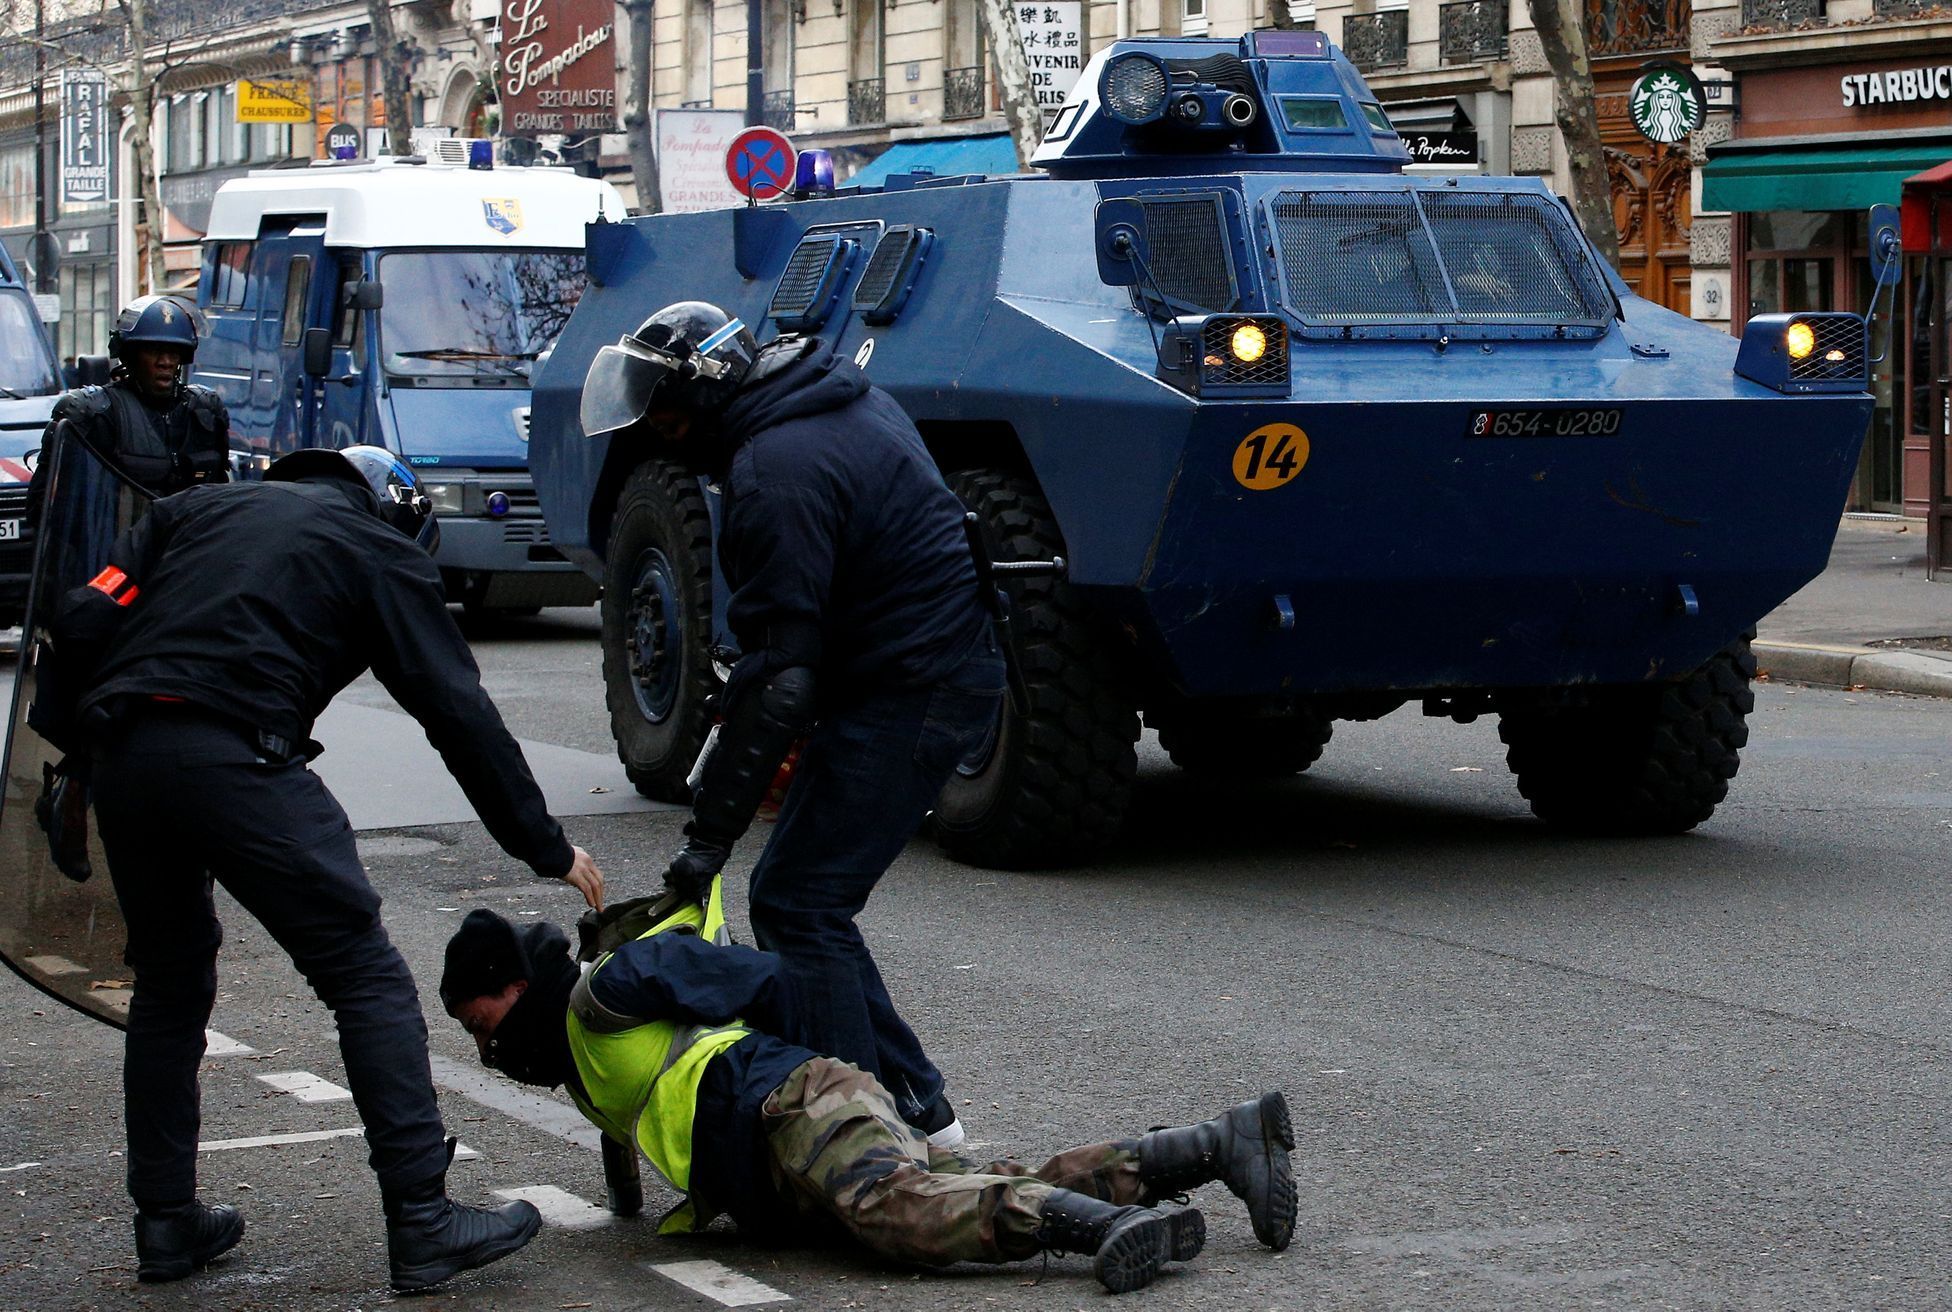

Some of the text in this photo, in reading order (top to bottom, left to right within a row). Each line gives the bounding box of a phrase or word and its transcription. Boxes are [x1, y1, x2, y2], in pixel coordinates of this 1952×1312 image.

[507, 0, 548, 45] La
[1032, 73, 1053, 86] DE
[1841, 65, 1952, 107] STARBUC
[537, 89, 614, 108] SPECIALISTE
[241, 106, 306, 117] CHAUSSURES
[78, 84, 92, 166] RAFAL
[514, 112, 614, 130] GRANDES TAILLES
[330, 134, 357, 148] BUS
[1418, 136, 1471, 161] Popken
[65, 167, 107, 178] GRANDE
[67, 179, 105, 191] TAILLE
[1706, 290, 1717, 303] 32
[1245, 434, 1298, 480] 14
[0, 521, 14, 537] 51
